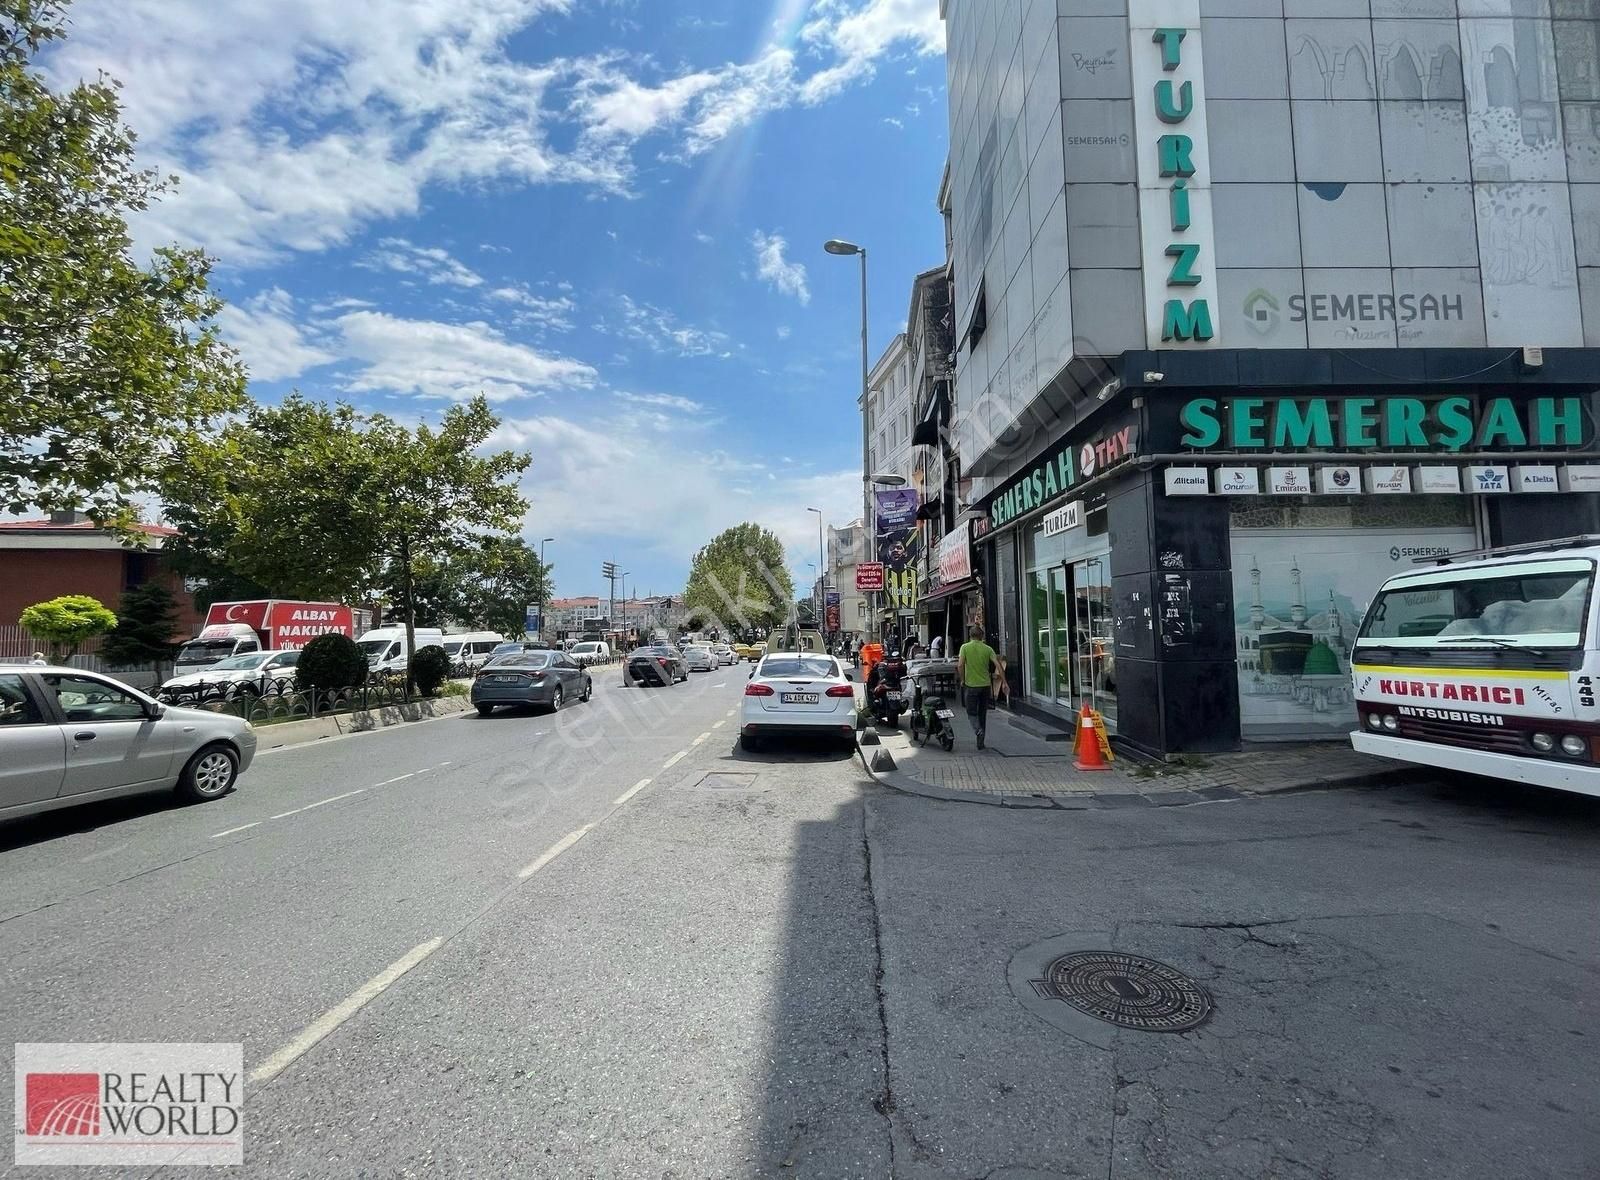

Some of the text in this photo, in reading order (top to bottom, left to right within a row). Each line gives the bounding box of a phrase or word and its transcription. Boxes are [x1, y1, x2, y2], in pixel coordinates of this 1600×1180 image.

[1151, 28, 1214, 342] TURİZM
[1287, 293, 1464, 322] SEMERŞAH
[1180, 397, 1583, 452] SEMERŞAH
[991, 427, 1130, 528] SEMERŞAH THY
[1174, 477, 1205, 485] Alitalia
[1532, 475, 1554, 483] Delta
[1044, 508, 1077, 534] TURİZM
[291, 609, 338, 621] ALBAY
[279, 622, 347, 637] NAKLİYAT
[280, 639, 295, 650] YÜK
[1360, 676, 1372, 695] Arda
[1379, 679, 1526, 706] KURTARICI
[1532, 685, 1563, 714] Miraç
[1398, 706, 1504, 726] MITSUBISHI
